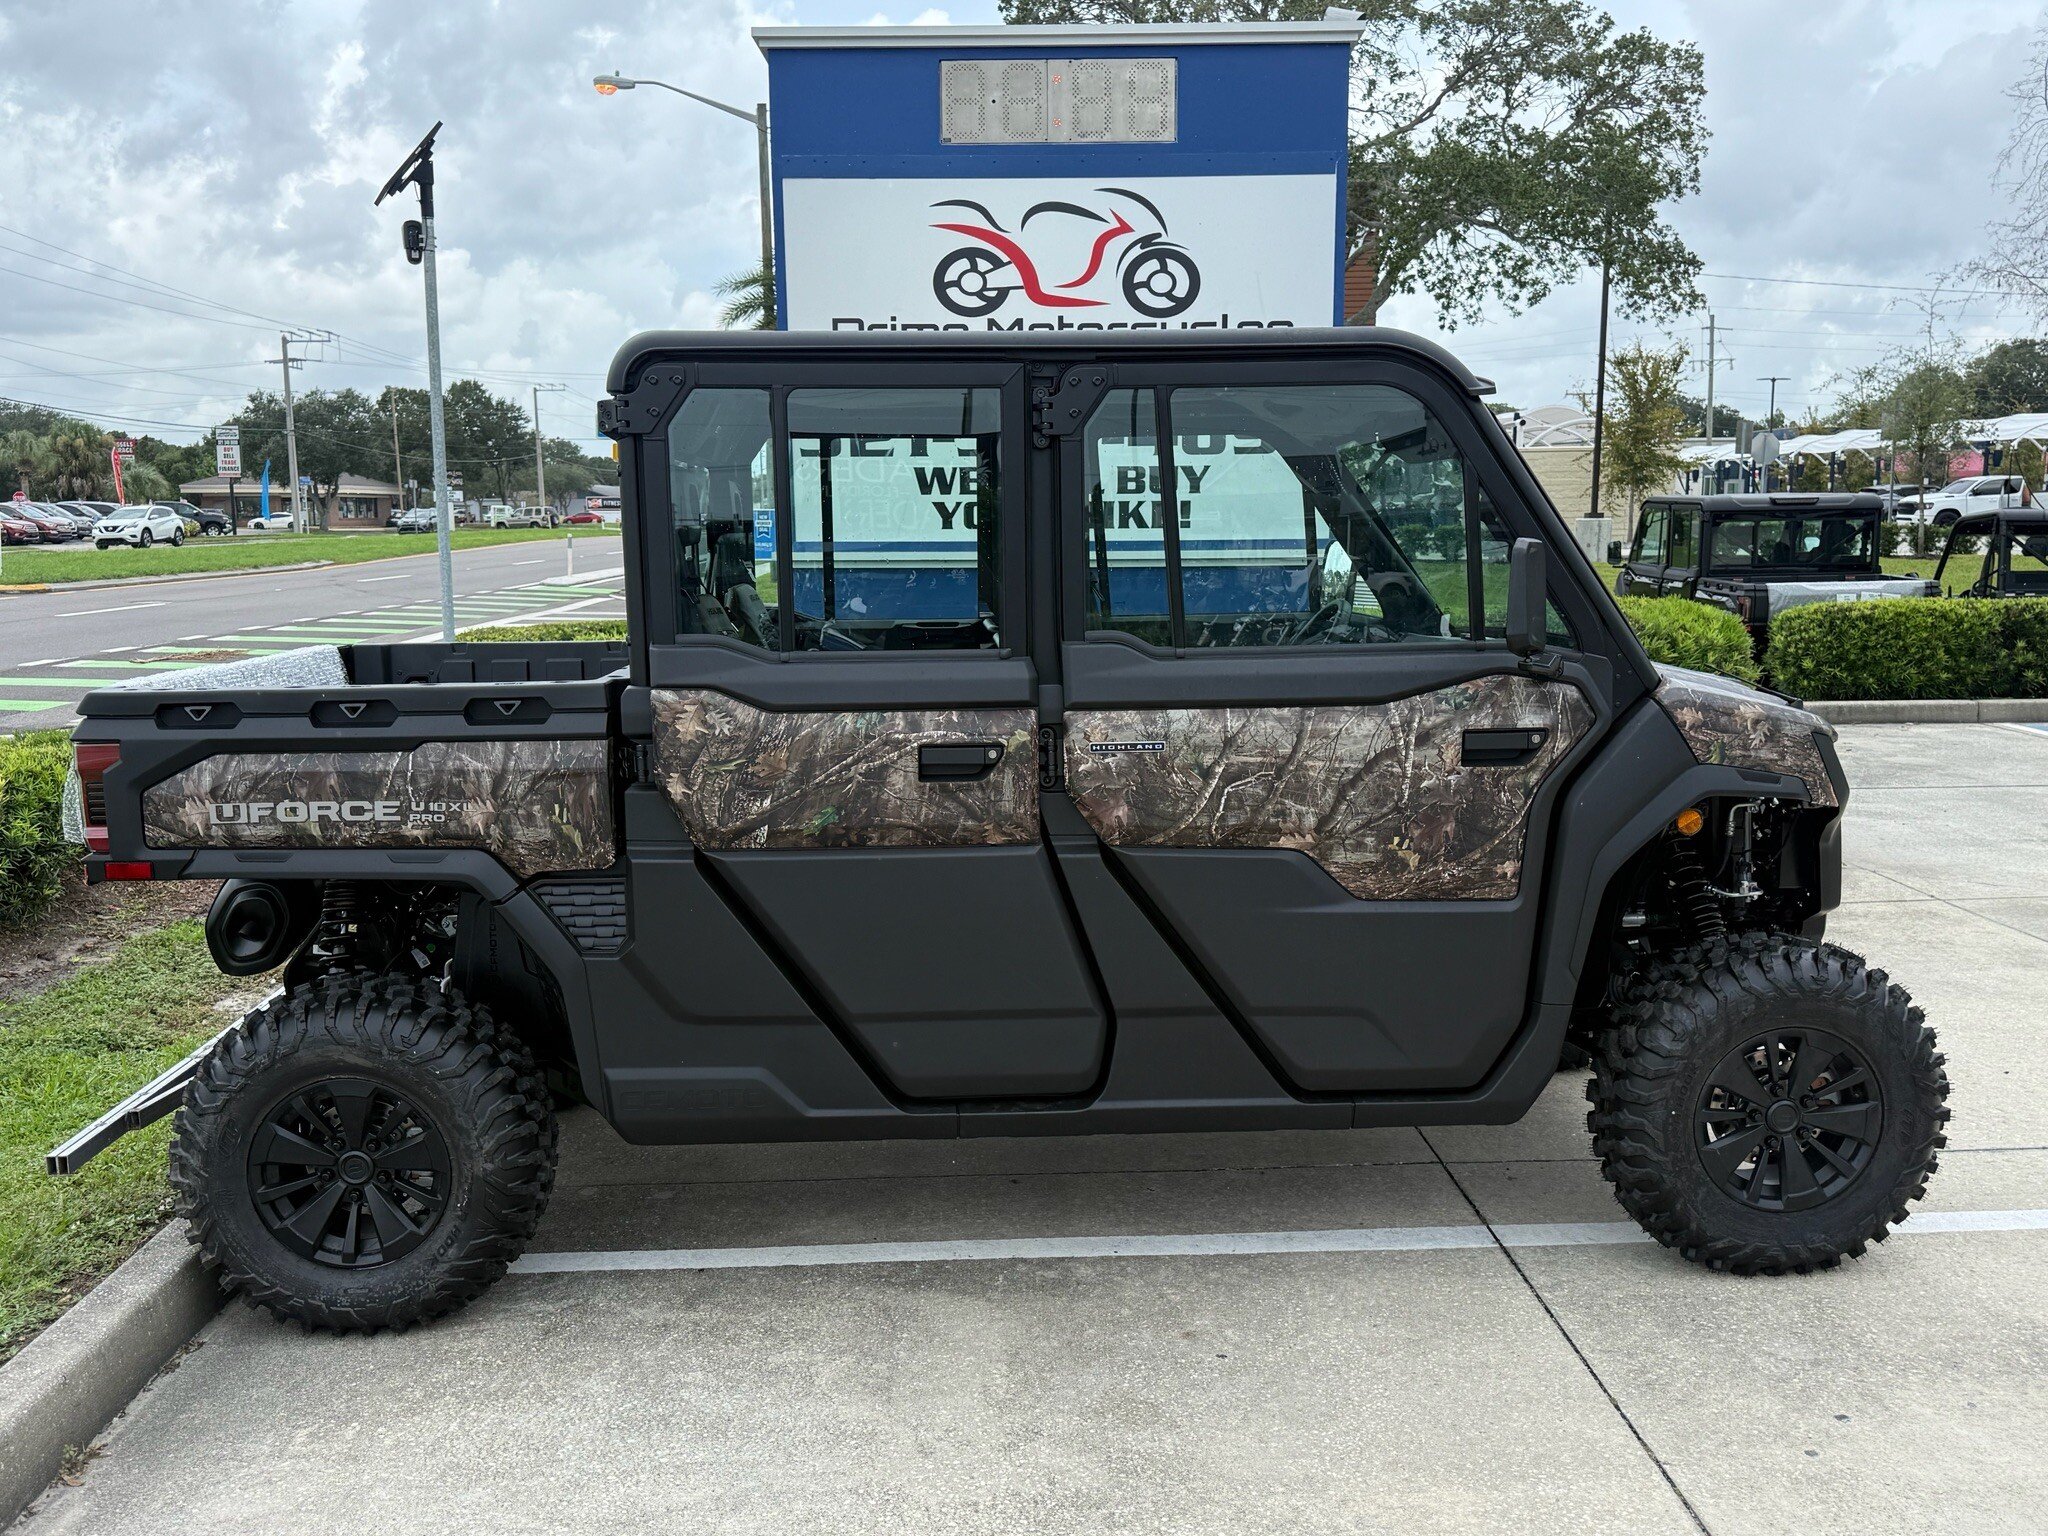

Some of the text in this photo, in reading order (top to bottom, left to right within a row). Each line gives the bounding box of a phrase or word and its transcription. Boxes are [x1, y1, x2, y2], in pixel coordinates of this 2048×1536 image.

[1116, 464, 1212, 495] BUY
[932, 501, 978, 530] YO
[1103, 500, 1192, 529] IKE!
[209, 800, 401, 825] UFORCE
[409, 813, 446, 822] PRO
